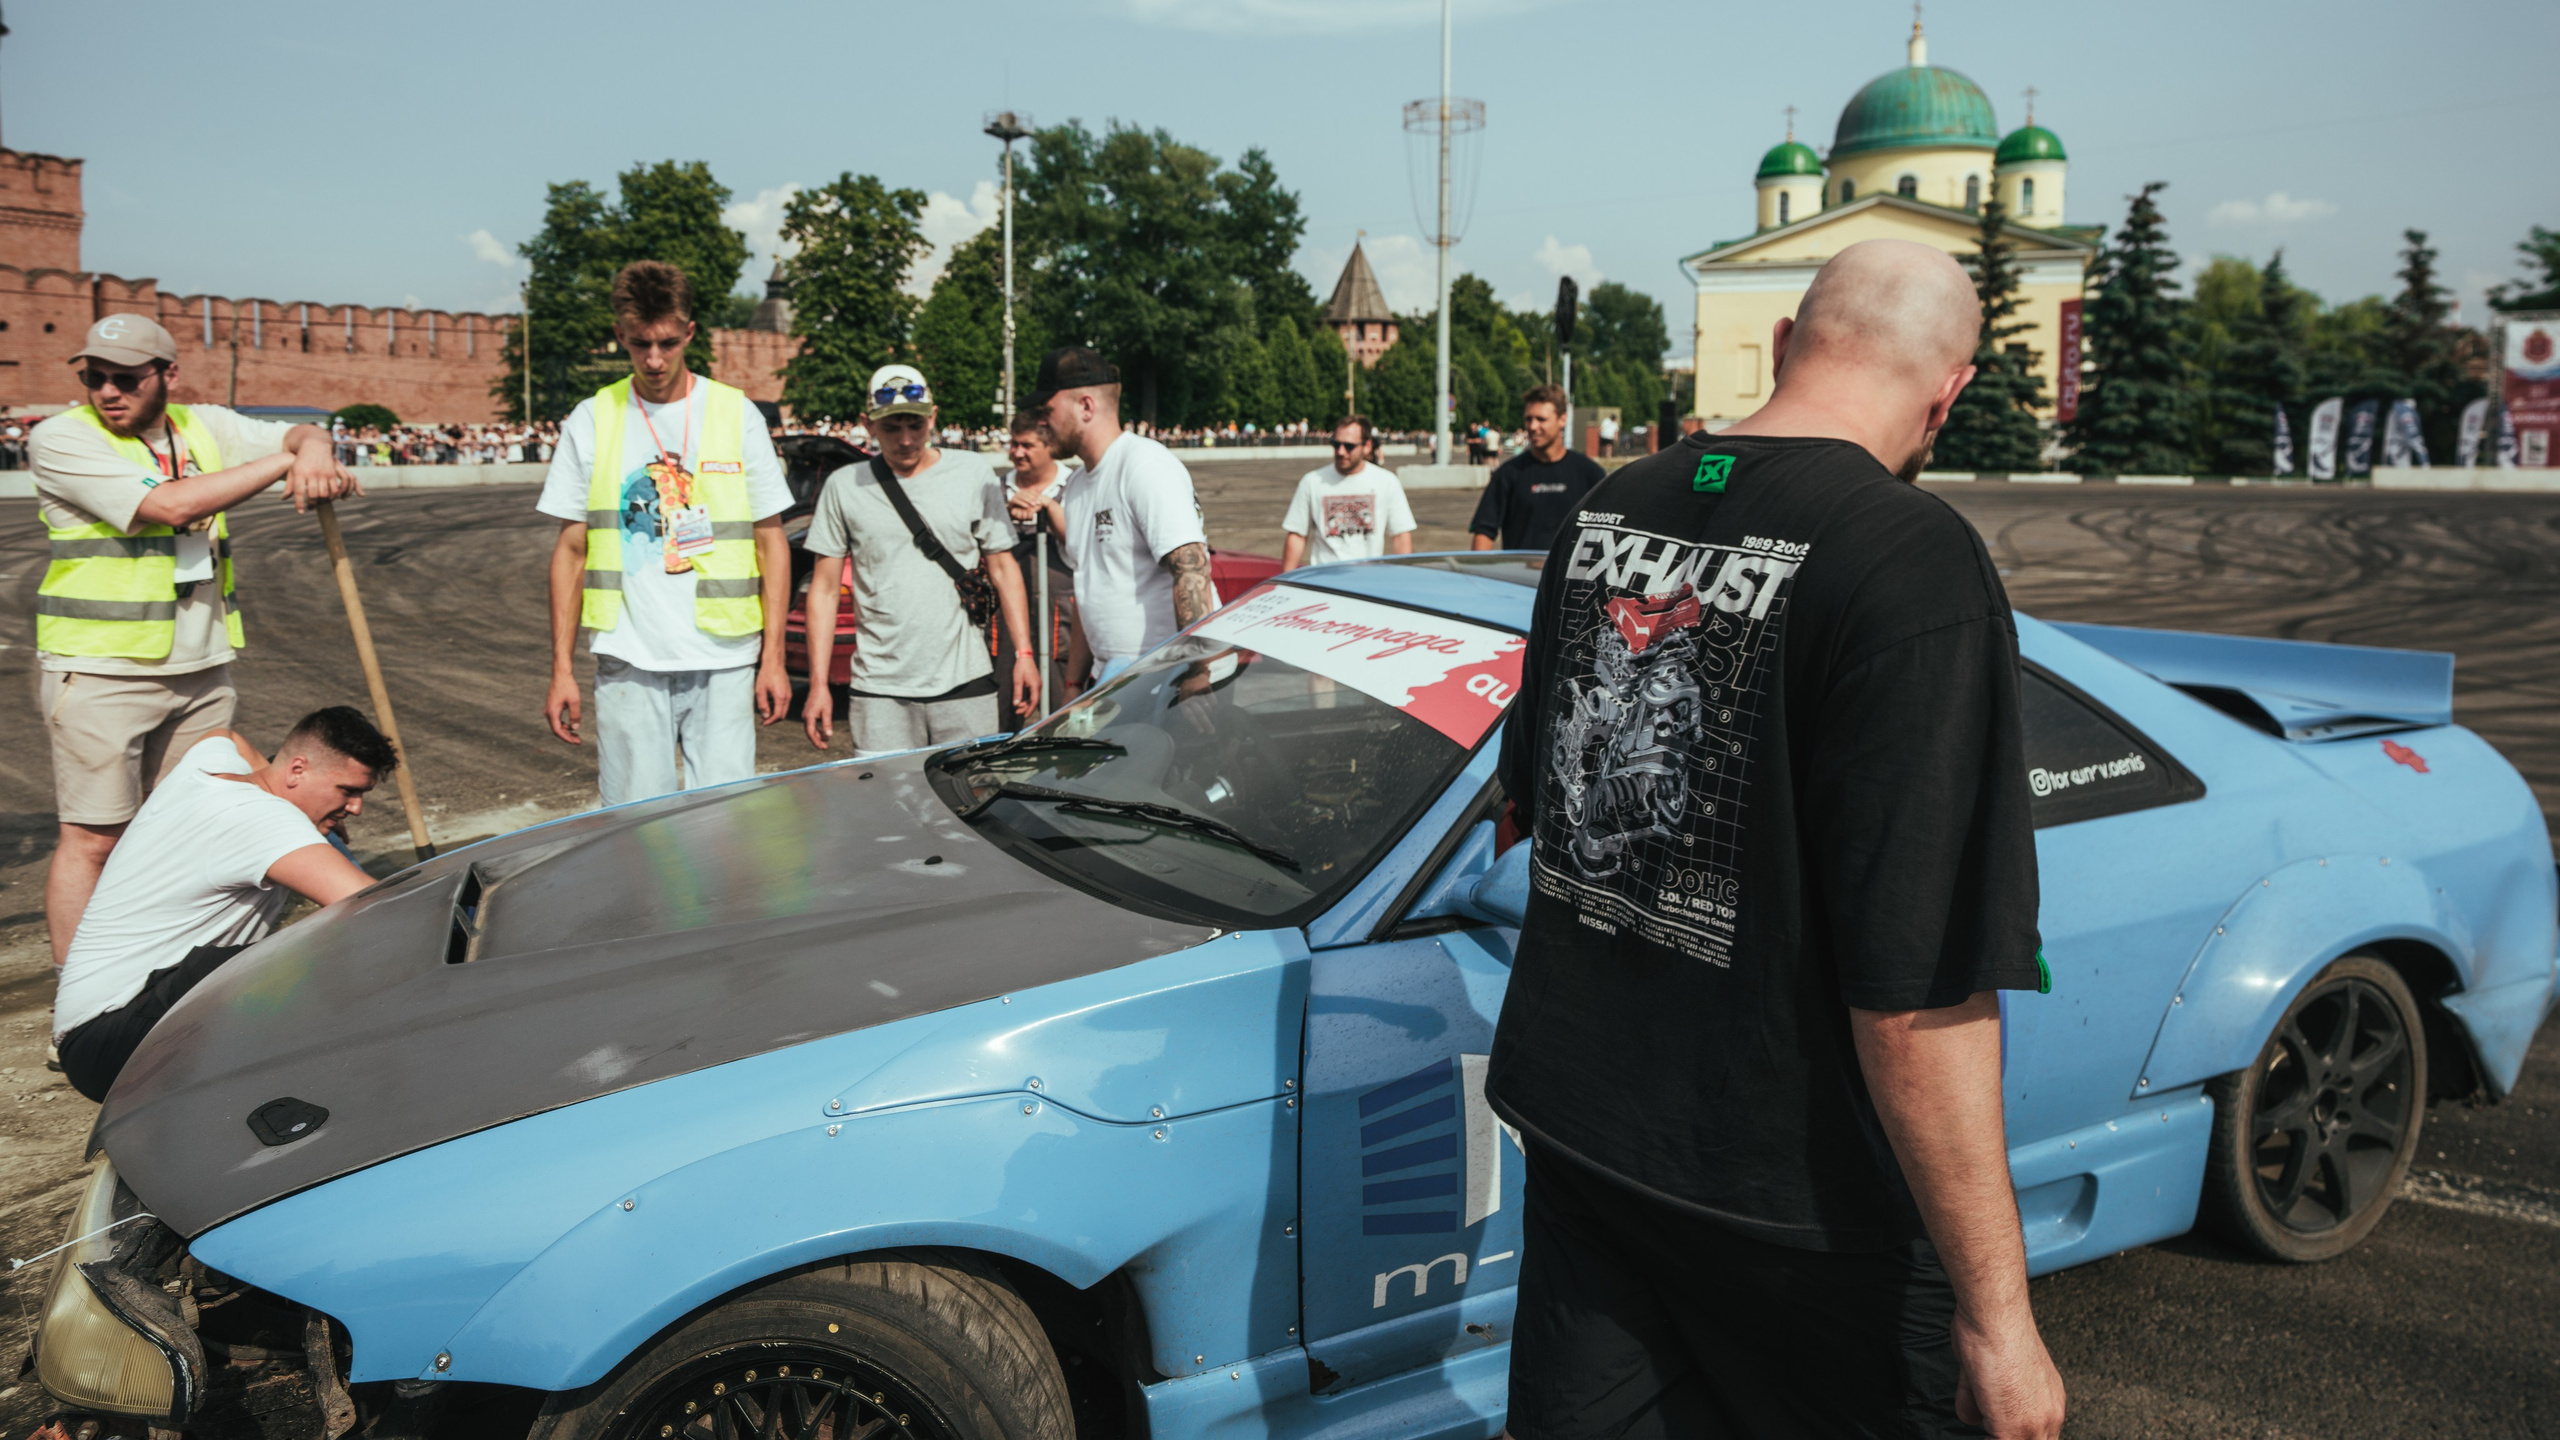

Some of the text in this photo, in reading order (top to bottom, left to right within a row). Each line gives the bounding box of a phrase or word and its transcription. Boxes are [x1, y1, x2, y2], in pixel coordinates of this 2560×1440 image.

[1565, 528, 1801, 621] EXHAUST
[1660, 861, 1739, 906] DOHC
[1657, 901, 1736, 932] Turbocharging Garrett
[1658, 889, 1683, 904] 2.0L
[1691, 897, 1714, 913] RED
[1715, 904, 1737, 920] TOP
[1578, 913, 1617, 936] NISSAN
